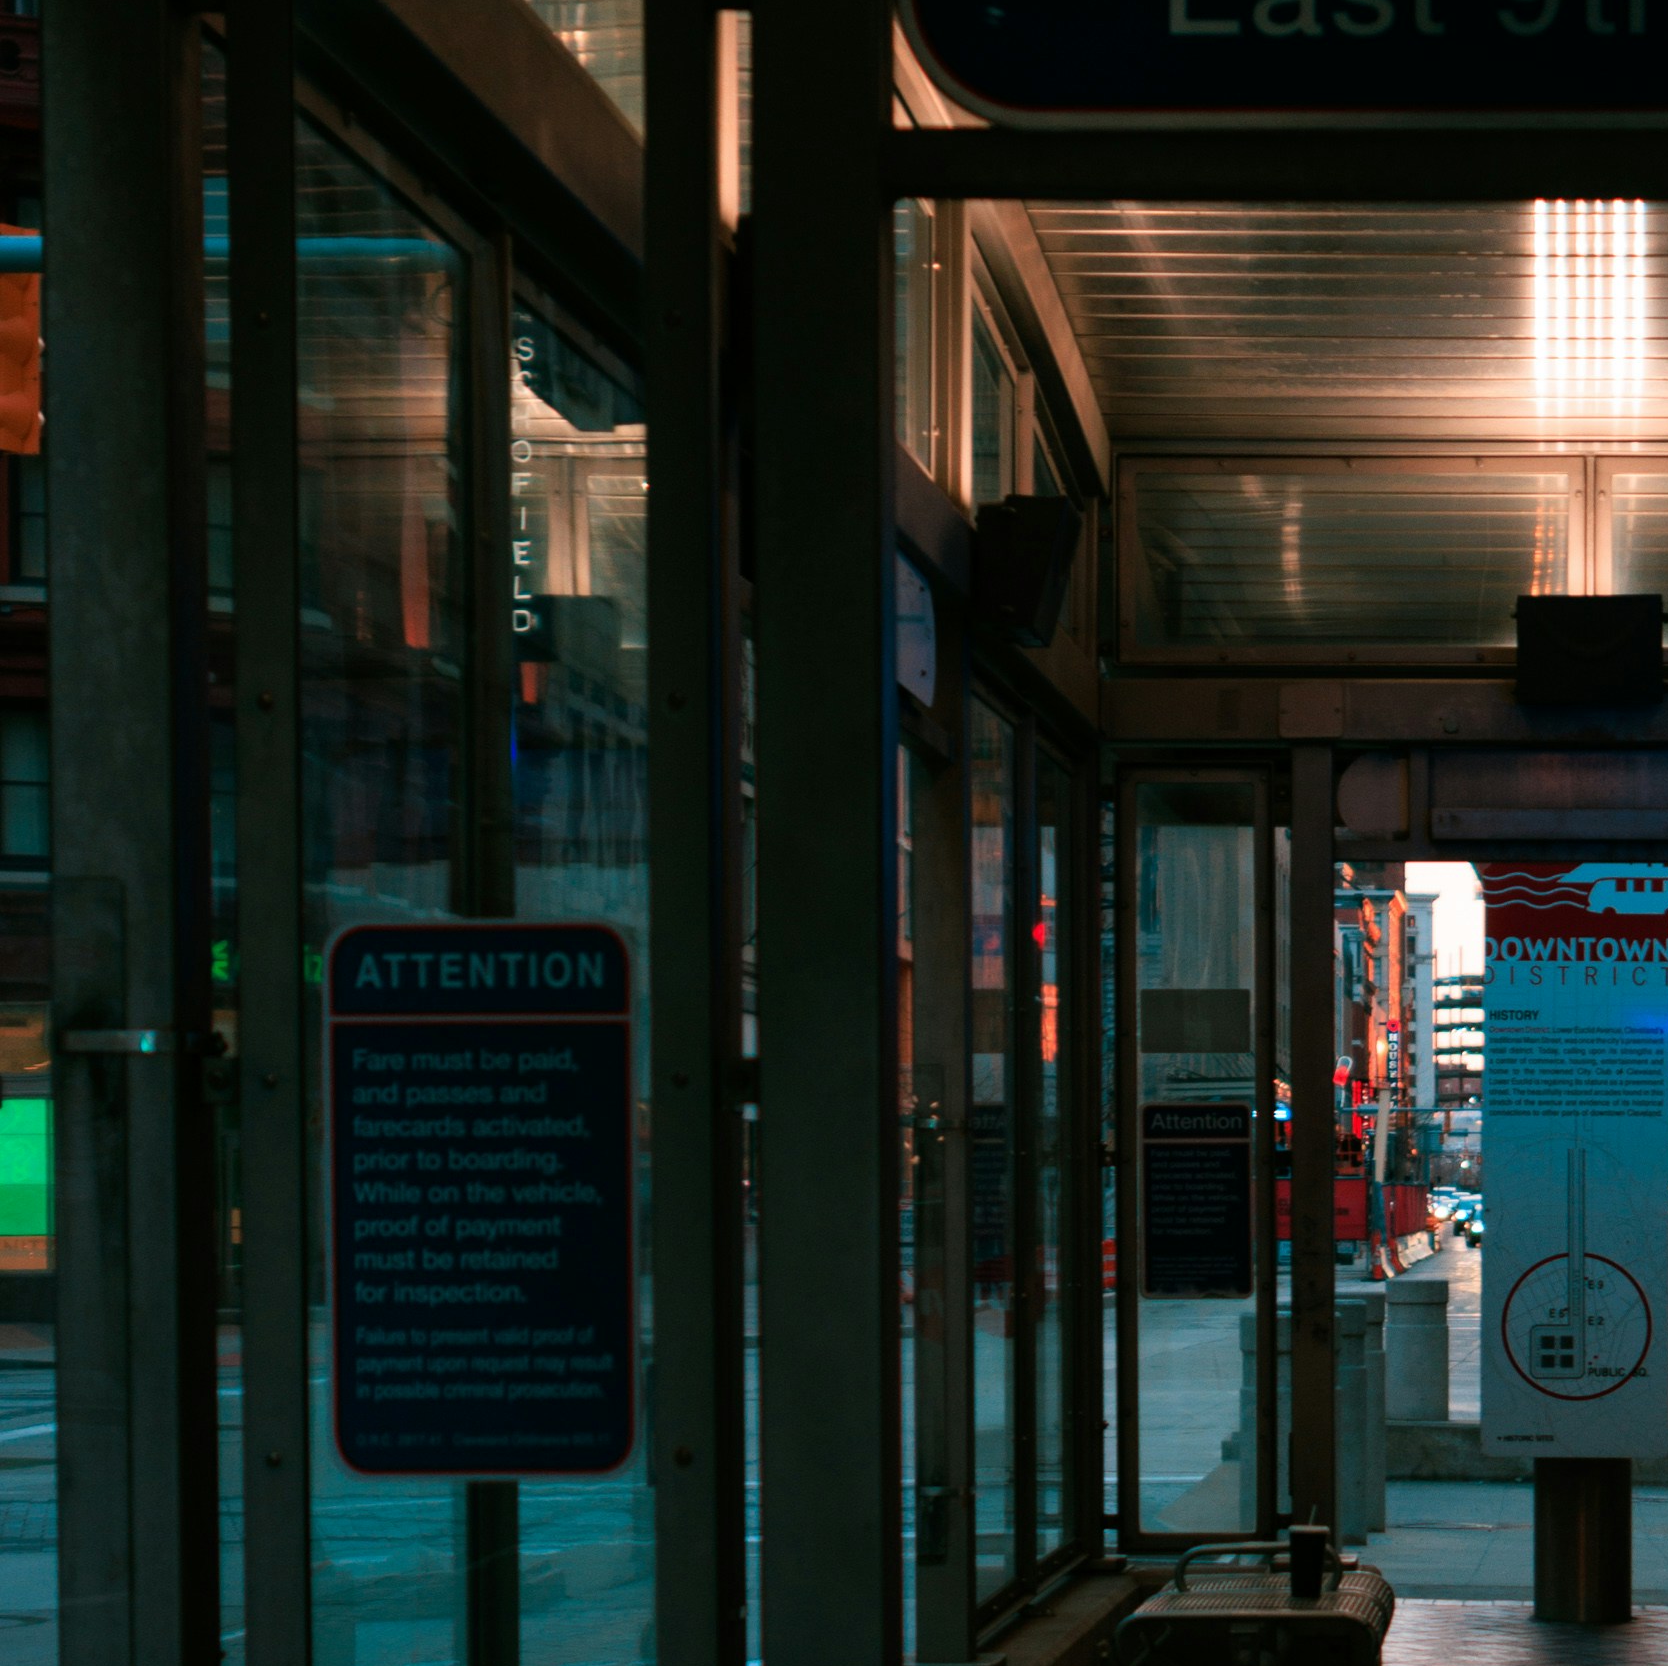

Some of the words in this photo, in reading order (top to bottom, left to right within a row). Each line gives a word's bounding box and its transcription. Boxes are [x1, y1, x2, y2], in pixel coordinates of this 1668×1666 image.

[355, 951, 604, 990] ATTENTION
[1489, 1009, 1539, 1021] HISTORY
[352, 1048, 404, 1071] Fare
[412, 1050, 472, 1071] must
[480, 1048, 511, 1071] be
[518, 1047, 579, 1074] paid,
[352, 1082, 397, 1104] and
[406, 1086, 492, 1107] passes
[500, 1081, 546, 1104] and
[353, 1116, 464, 1137] farecards
[472, 1115, 590, 1140] activated,
[1150, 1112, 1243, 1130] Attention
[353, 1148, 409, 1174] prior
[417, 1150, 441, 1170] to
[448, 1147, 564, 1175] boarding.
[353, 1181, 421, 1204] While
[428, 1186, 459, 1204] on
[466, 1181, 505, 1204] the
[512, 1181, 603, 1206] vehicle,
[354, 1215, 419, 1241] proof
[425, 1215, 450, 1237] of
[456, 1216, 563, 1242] payment
[355, 1249, 415, 1270] must
[423, 1248, 453, 1270] be
[460, 1247, 559, 1270] retained
[355, 1281, 387, 1303] for
[394, 1282, 527, 1307] inspection.
[1588, 1281, 1594, 1289] E
[1598, 1281, 1604, 1289] 9
[1549, 1308, 1555, 1318] E
[1588, 1367, 1626, 1377] PUBLIC
